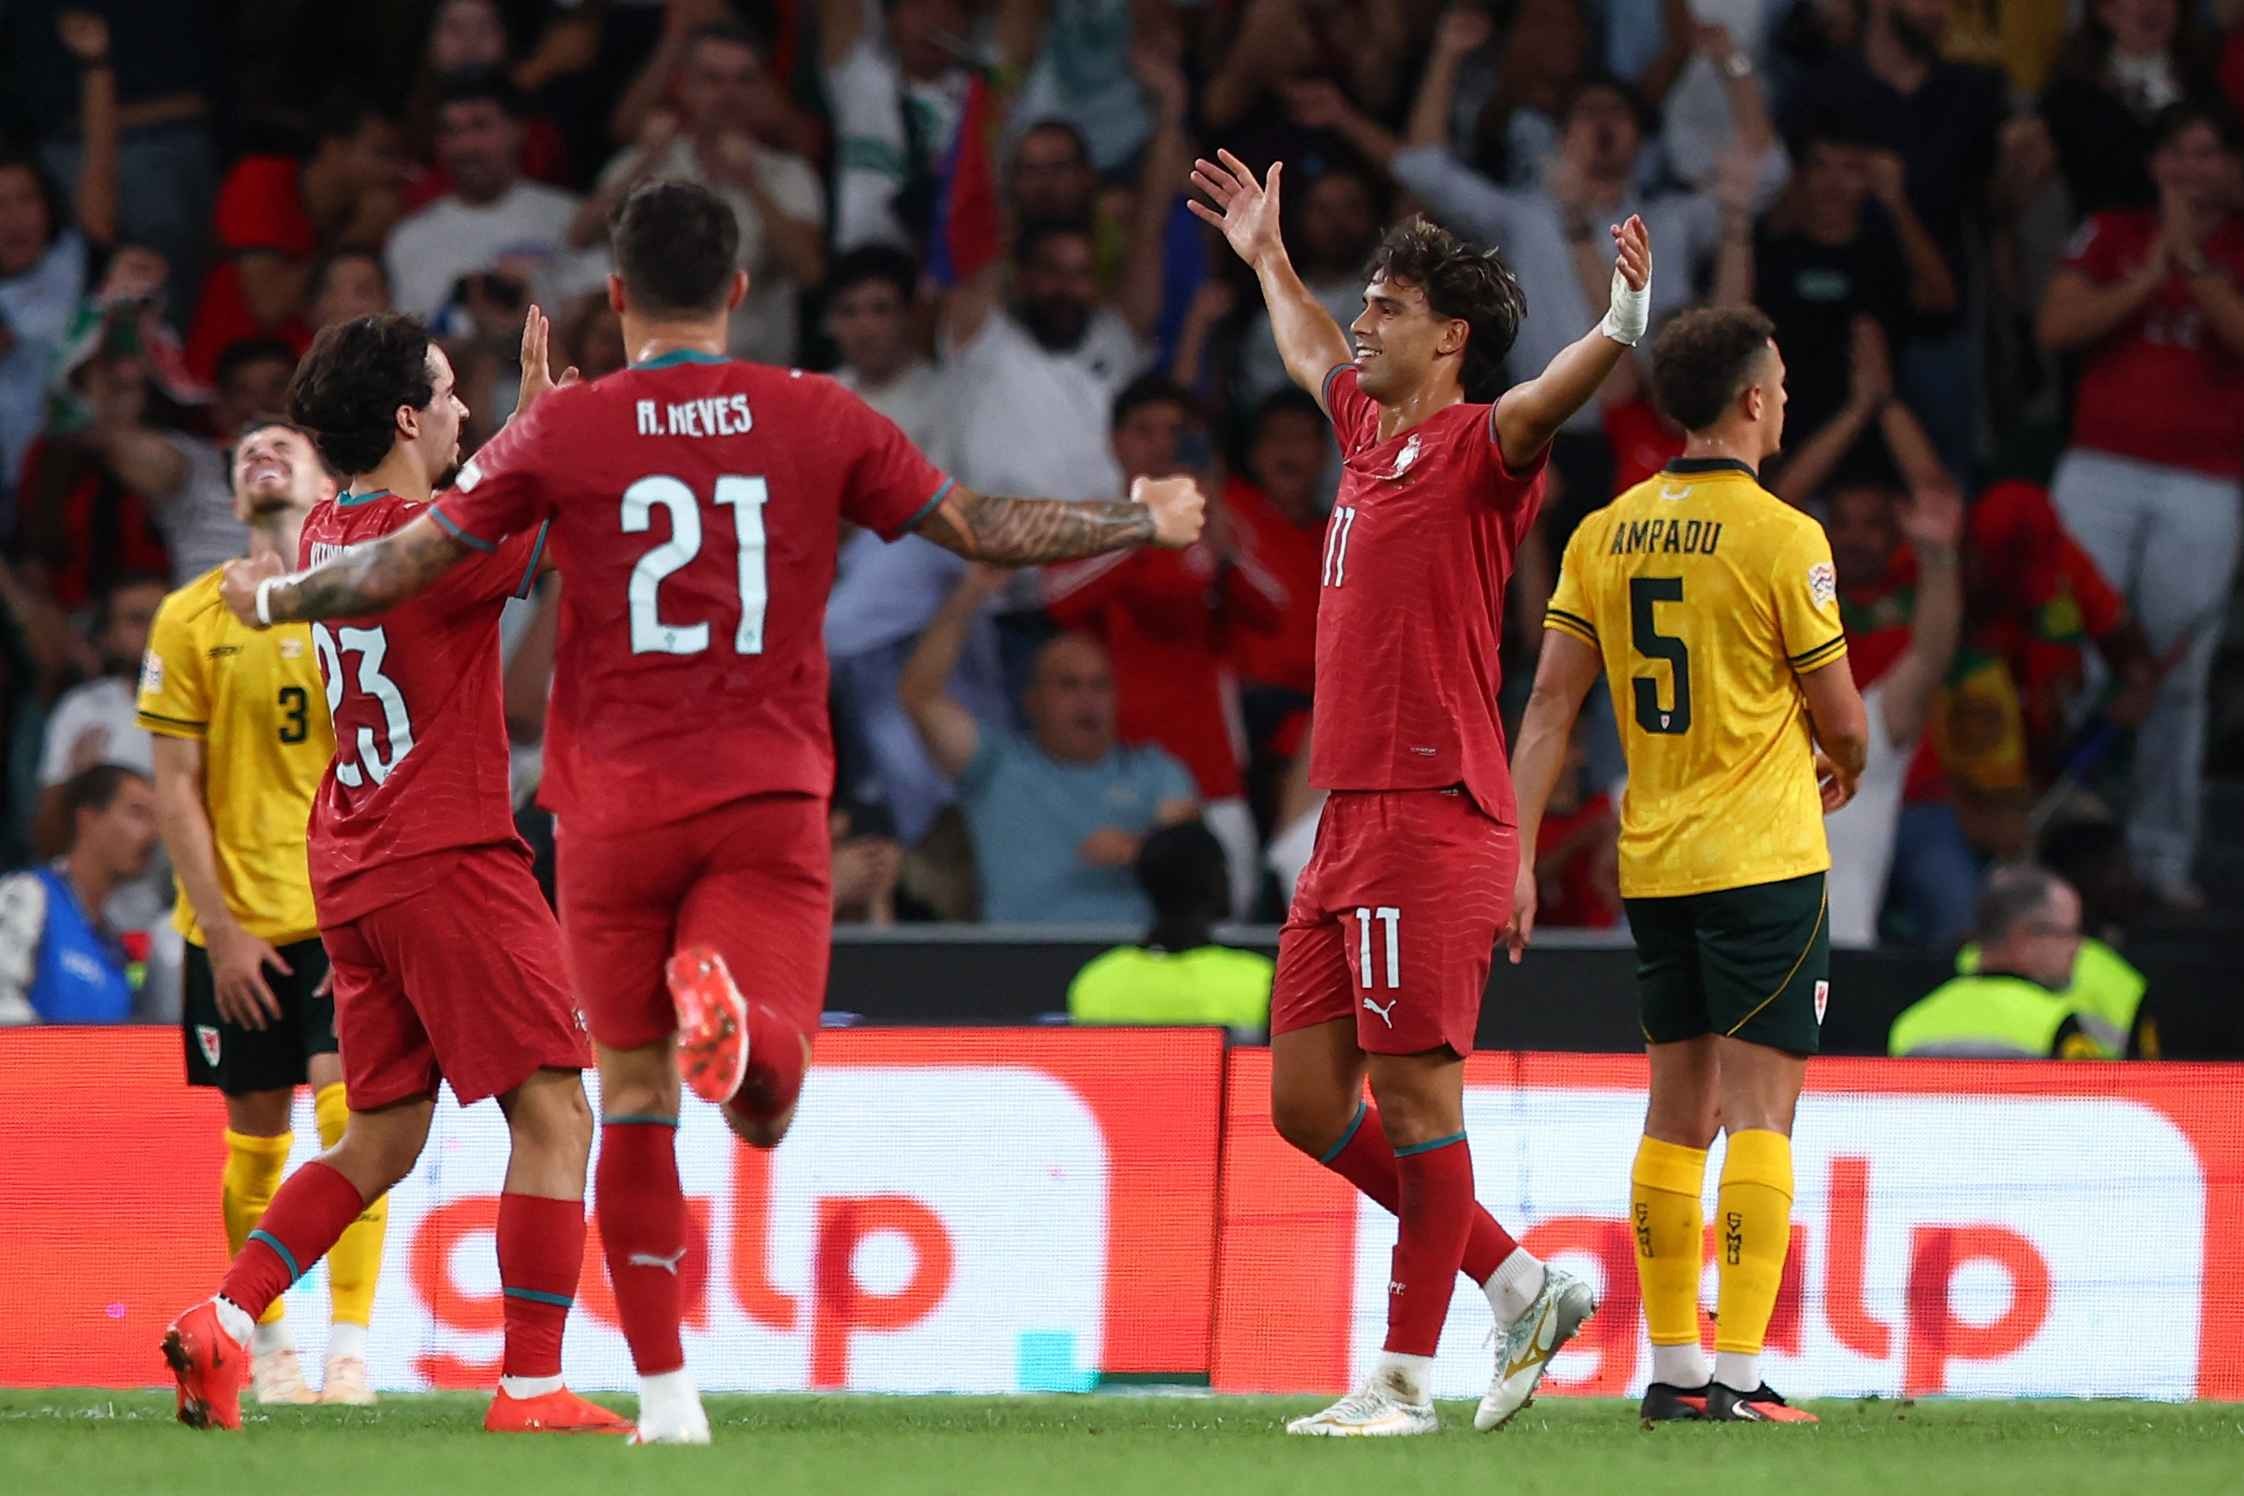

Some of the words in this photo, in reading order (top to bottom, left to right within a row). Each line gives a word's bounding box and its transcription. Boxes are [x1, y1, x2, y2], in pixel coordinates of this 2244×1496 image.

[620, 475, 768, 655] 21
[1322, 506, 1355, 587] 11
[1610, 519, 1722, 555] AMPADU
[1629, 577, 1691, 735] 5
[279, 686, 308, 743] 3
[312, 621, 414, 787] 23
[1356, 906, 1400, 989] 11
